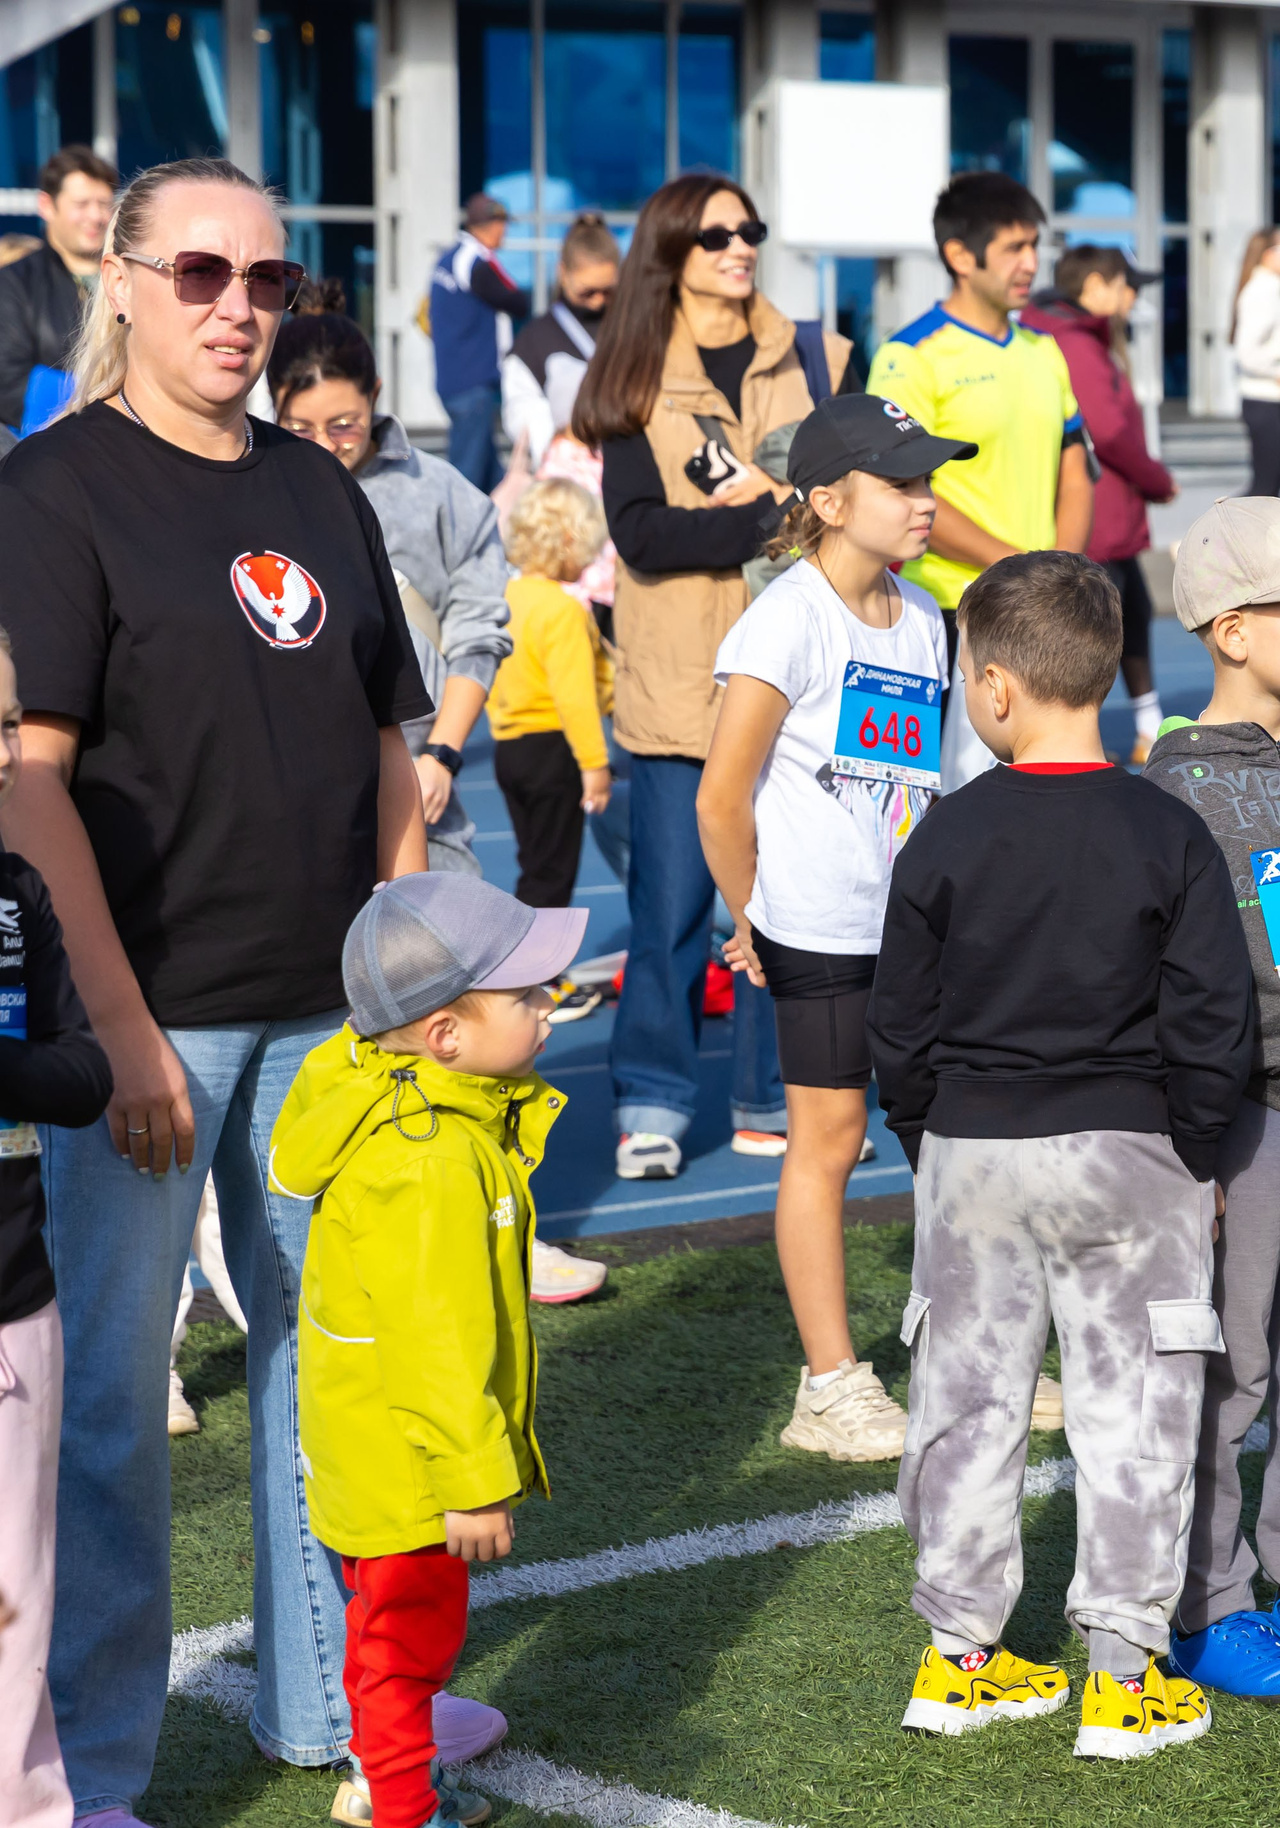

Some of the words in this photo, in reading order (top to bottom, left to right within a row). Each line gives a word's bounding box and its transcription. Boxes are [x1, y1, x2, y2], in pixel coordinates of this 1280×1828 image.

[865, 668, 922, 690] ДИНАМОВСКАЯ
[881, 684, 903, 697] МИЛЯ
[859, 706, 922, 757] 648
[0, 993, 27, 1007] ВСКАЯ
